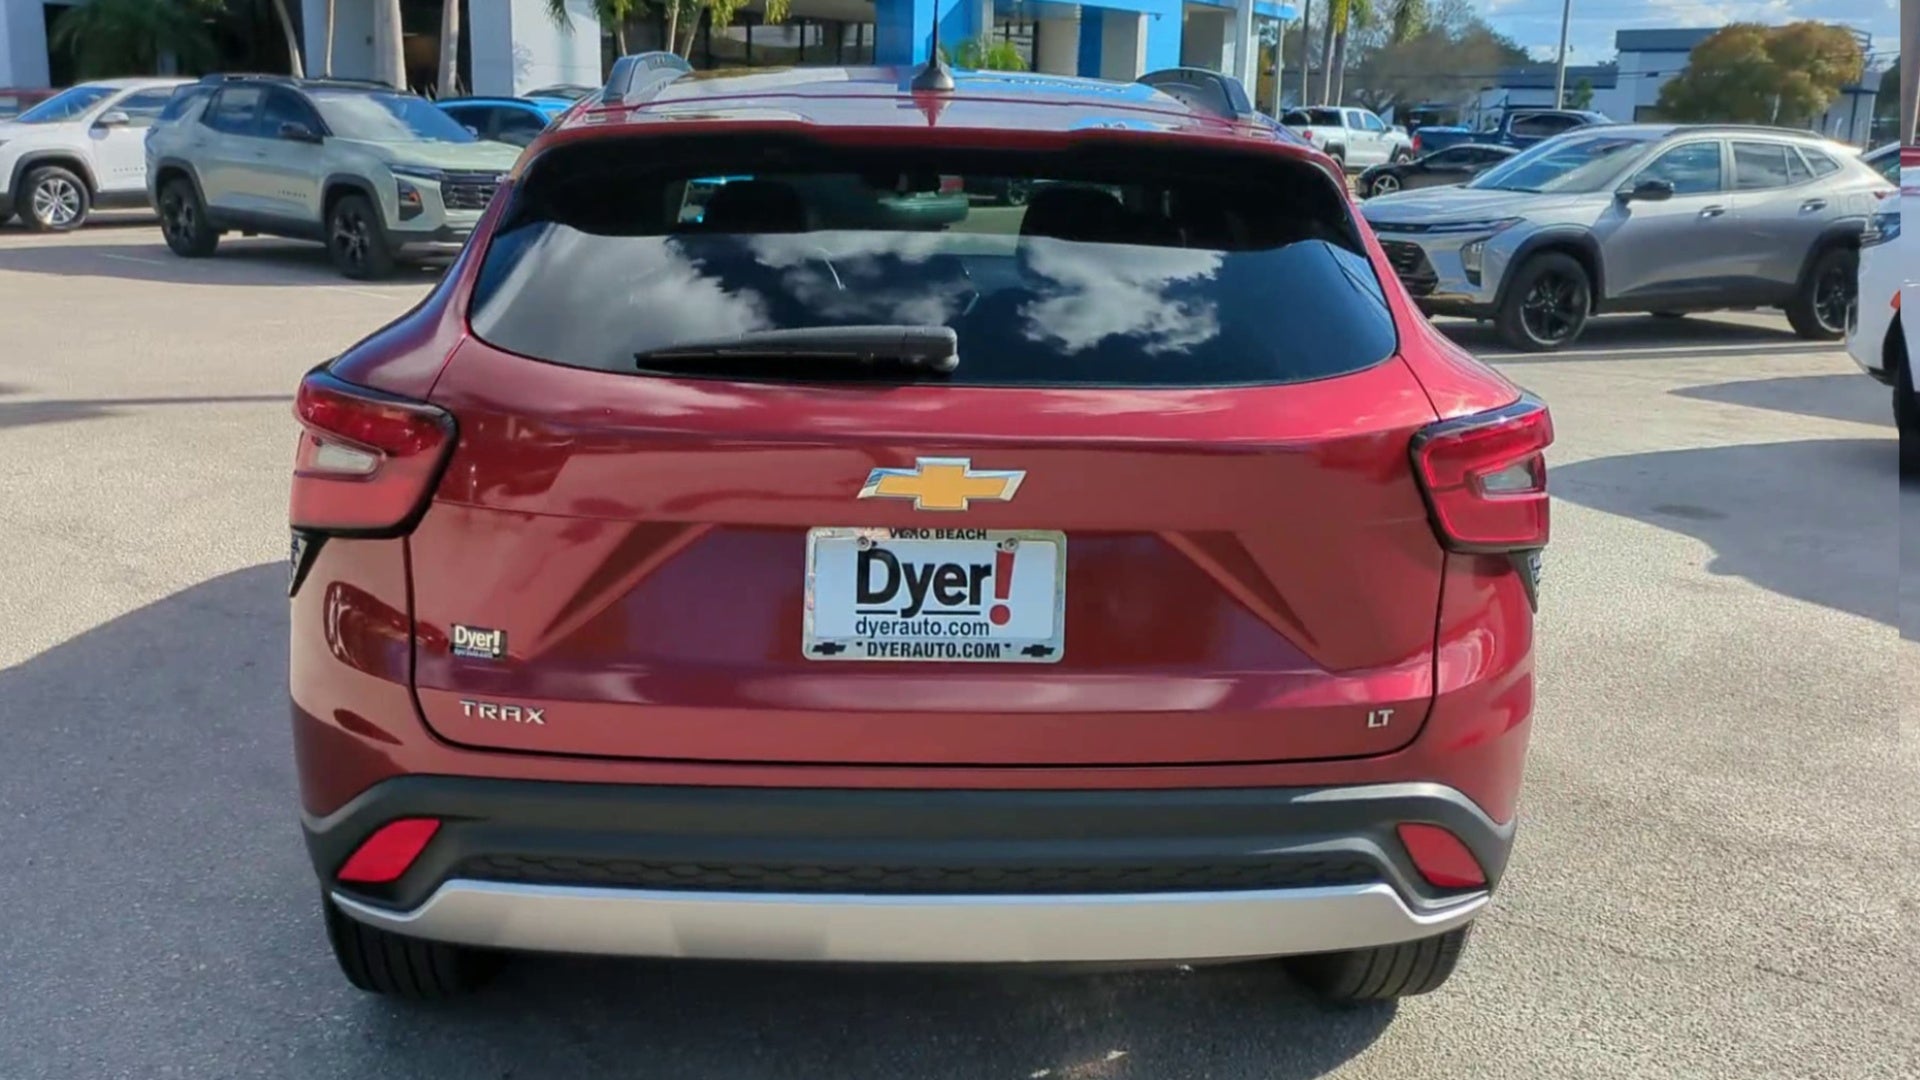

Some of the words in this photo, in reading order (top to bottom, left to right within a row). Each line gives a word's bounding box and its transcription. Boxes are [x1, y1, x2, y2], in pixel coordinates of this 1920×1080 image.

[935, 528, 987, 540] BEACH
[856, 547, 1016, 626] Dyer!
[855, 617, 990, 638] dyerauto.com
[454, 624, 501, 655] Dyer!
[867, 641, 1000, 658] DYERAUTO.COM
[459, 700, 546, 725] TRAX
[1368, 709, 1394, 728] LT
